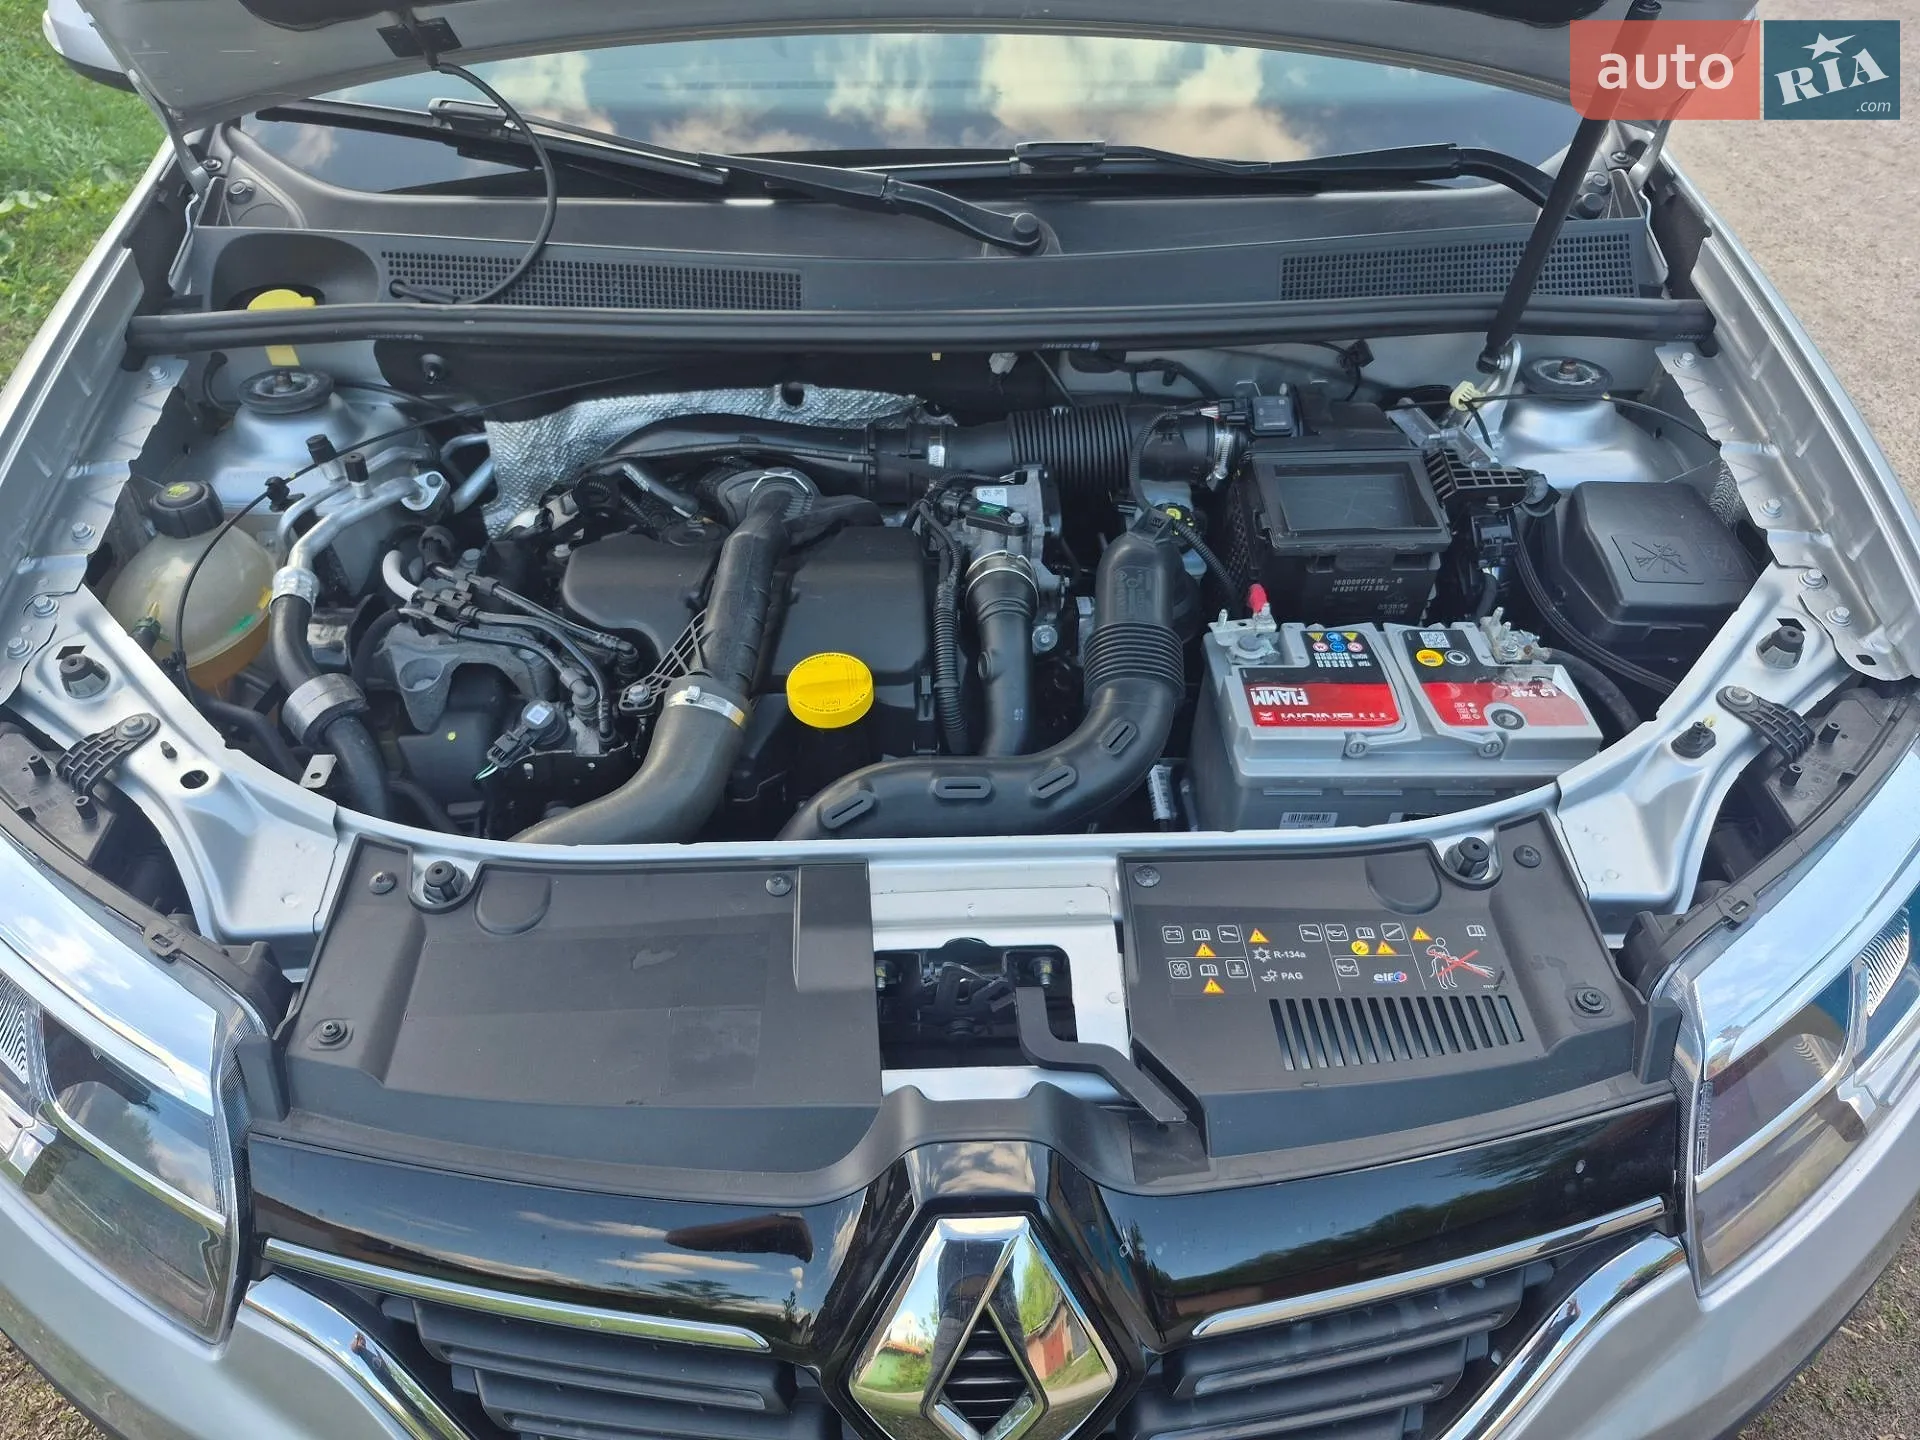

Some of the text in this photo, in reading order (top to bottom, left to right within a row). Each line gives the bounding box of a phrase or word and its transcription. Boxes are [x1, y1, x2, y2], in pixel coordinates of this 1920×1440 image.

[1250, 689, 1309, 706] FIAMM
[1273, 950, 1306, 959] R-134a
[1280, 972, 1304, 980] PAG
[1373, 972, 1394, 982] elf
